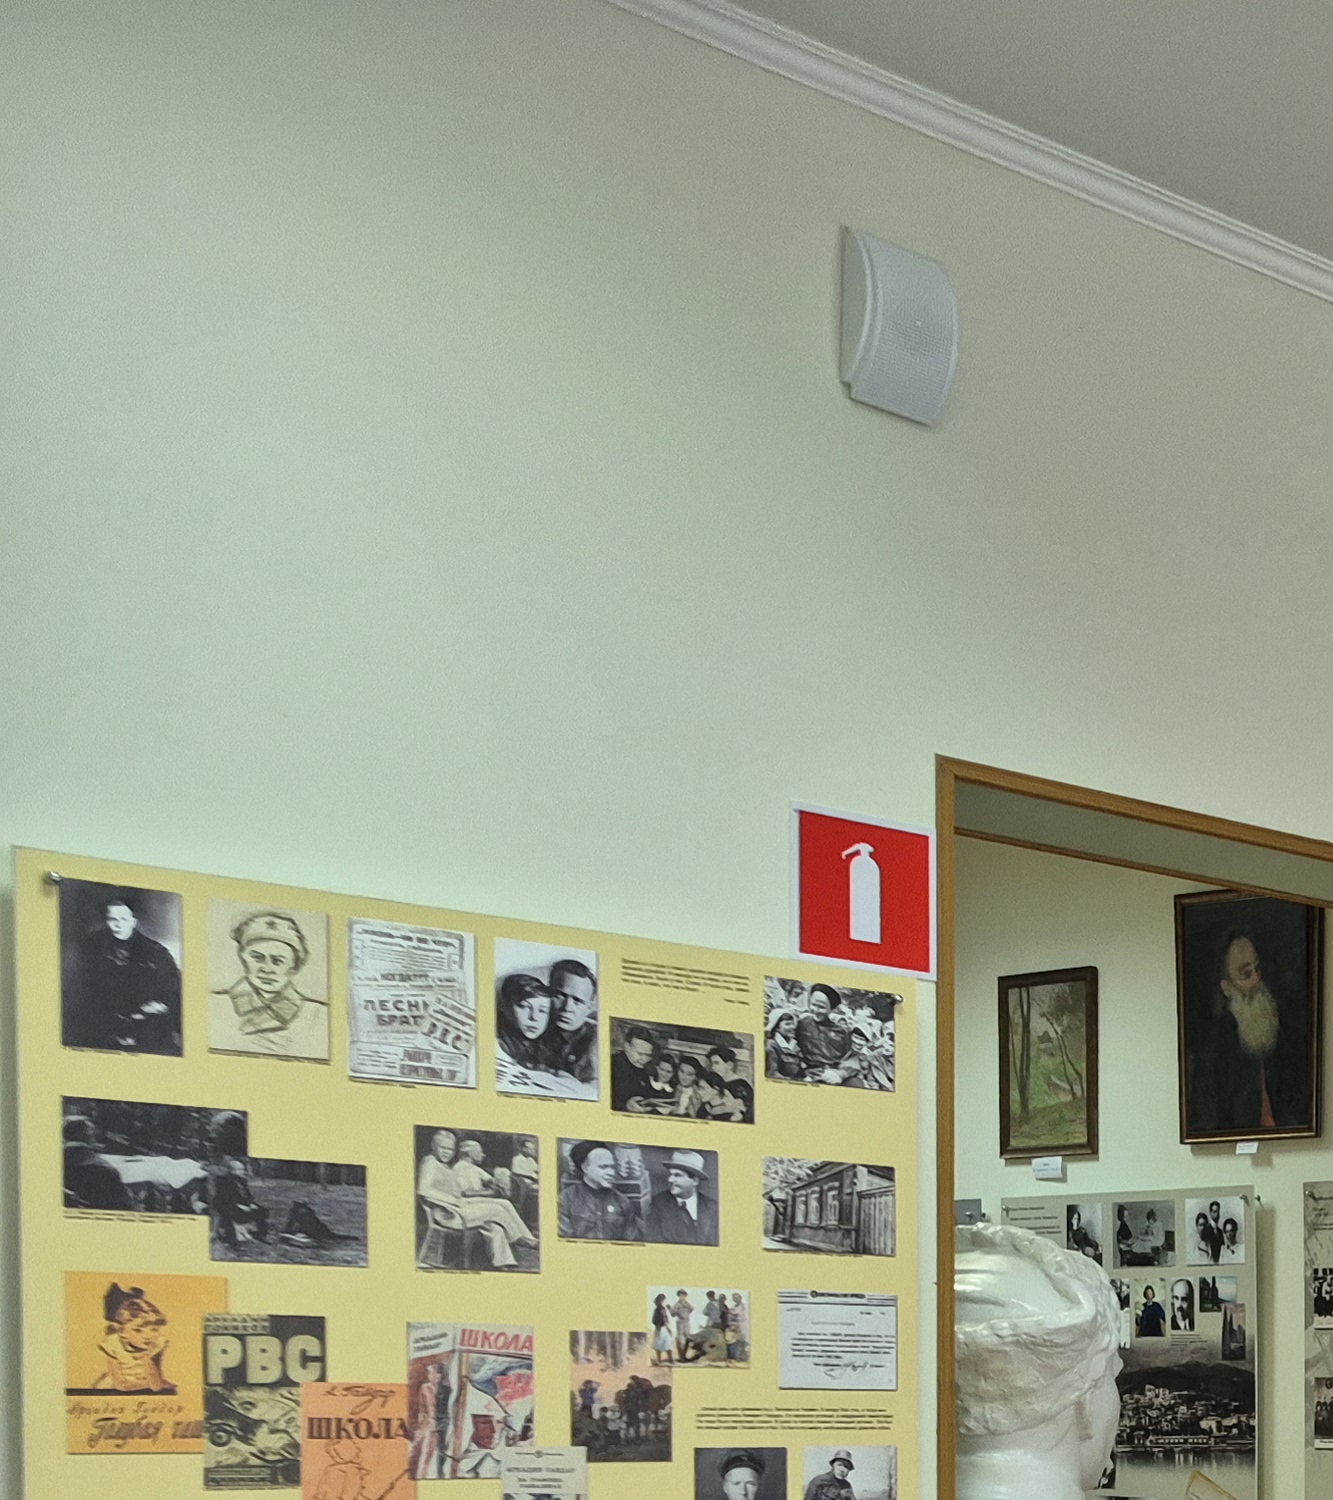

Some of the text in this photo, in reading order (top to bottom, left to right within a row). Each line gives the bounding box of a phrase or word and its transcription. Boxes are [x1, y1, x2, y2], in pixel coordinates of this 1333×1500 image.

[460, 1328, 533, 1350] ШКОЛА
[207, 1335, 324, 1384] РВС
[307, 1417, 410, 1440] ШКОЛА
